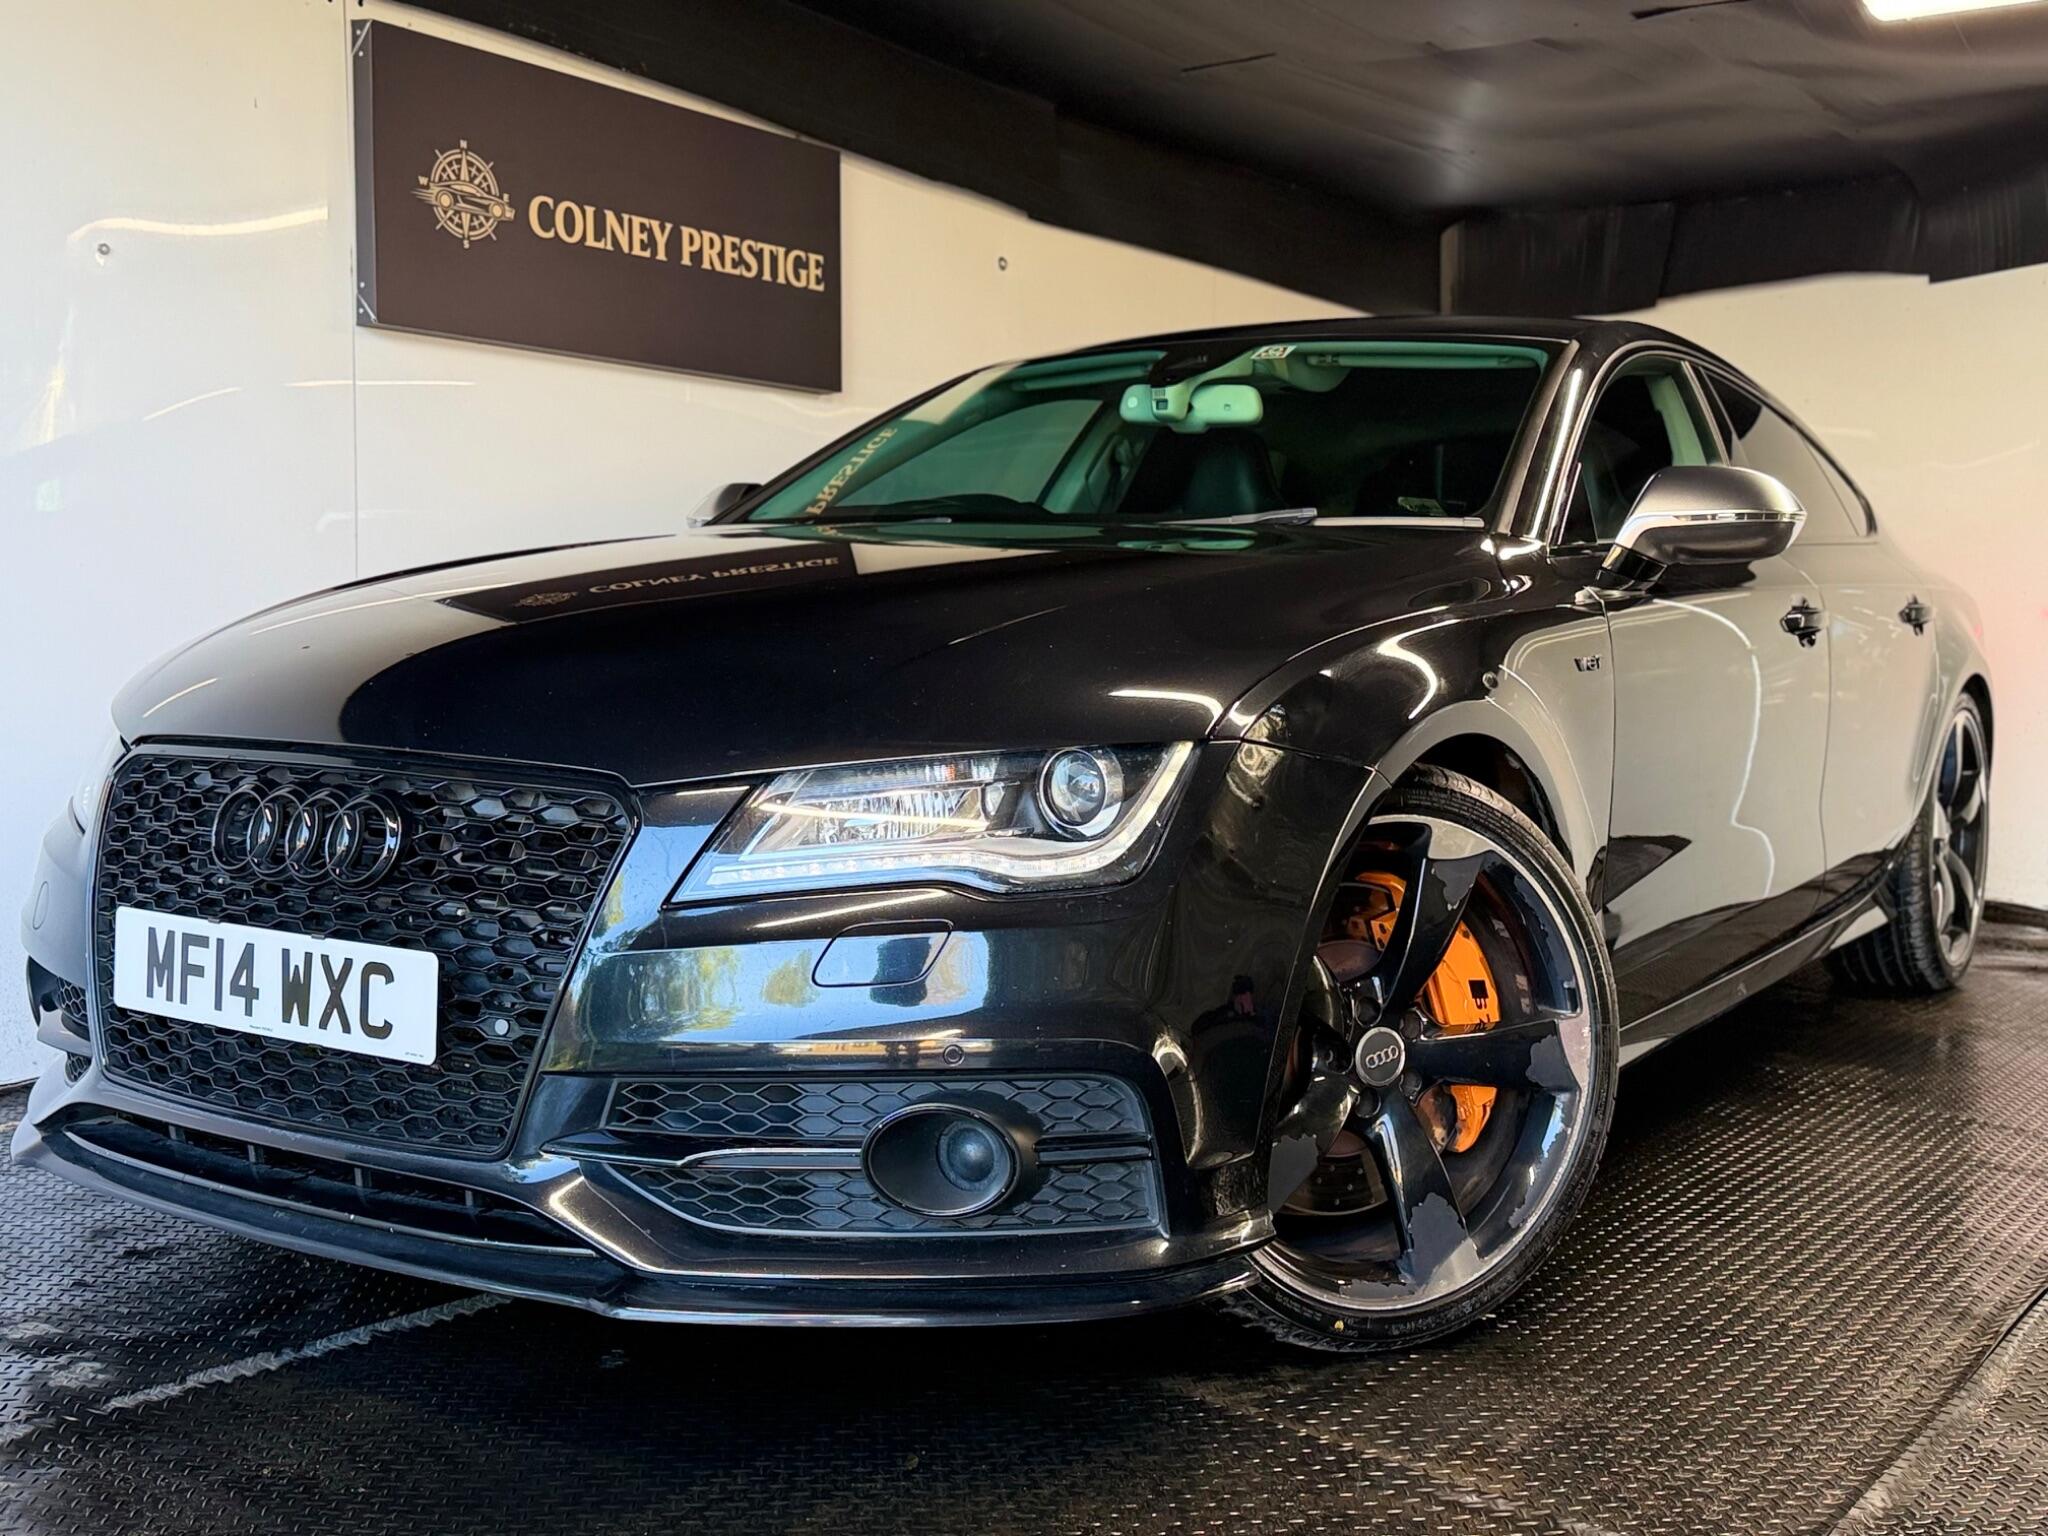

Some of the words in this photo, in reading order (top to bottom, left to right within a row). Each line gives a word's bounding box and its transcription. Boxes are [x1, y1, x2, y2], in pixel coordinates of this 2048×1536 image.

[528, 194, 673, 262] COLNEY
[680, 225, 825, 292] PRESTIGE
[146, 926, 259, 1017] MF14
[281, 948, 395, 1040] WXC
